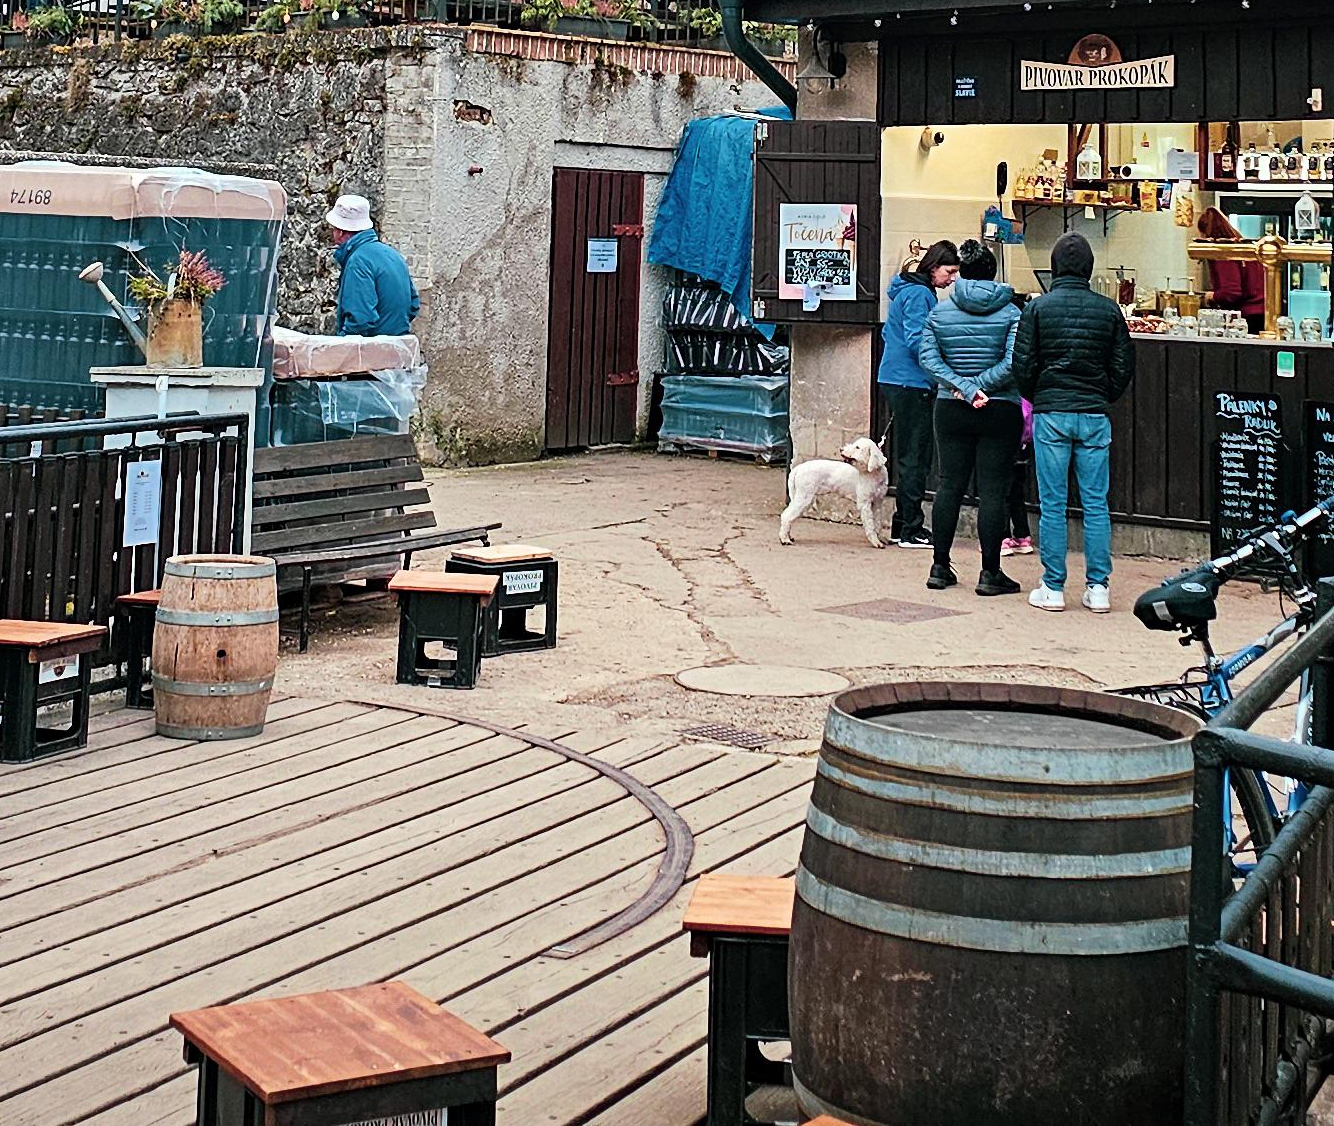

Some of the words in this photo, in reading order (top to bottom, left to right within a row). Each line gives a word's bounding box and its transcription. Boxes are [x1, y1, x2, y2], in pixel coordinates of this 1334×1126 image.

[1025, 65, 1084, 88] PIVOVAR
[1089, 59, 1169, 86] PROKOPÁK
[10, 188, 53, 205] 89174
[784, 222, 837, 244] Točená
